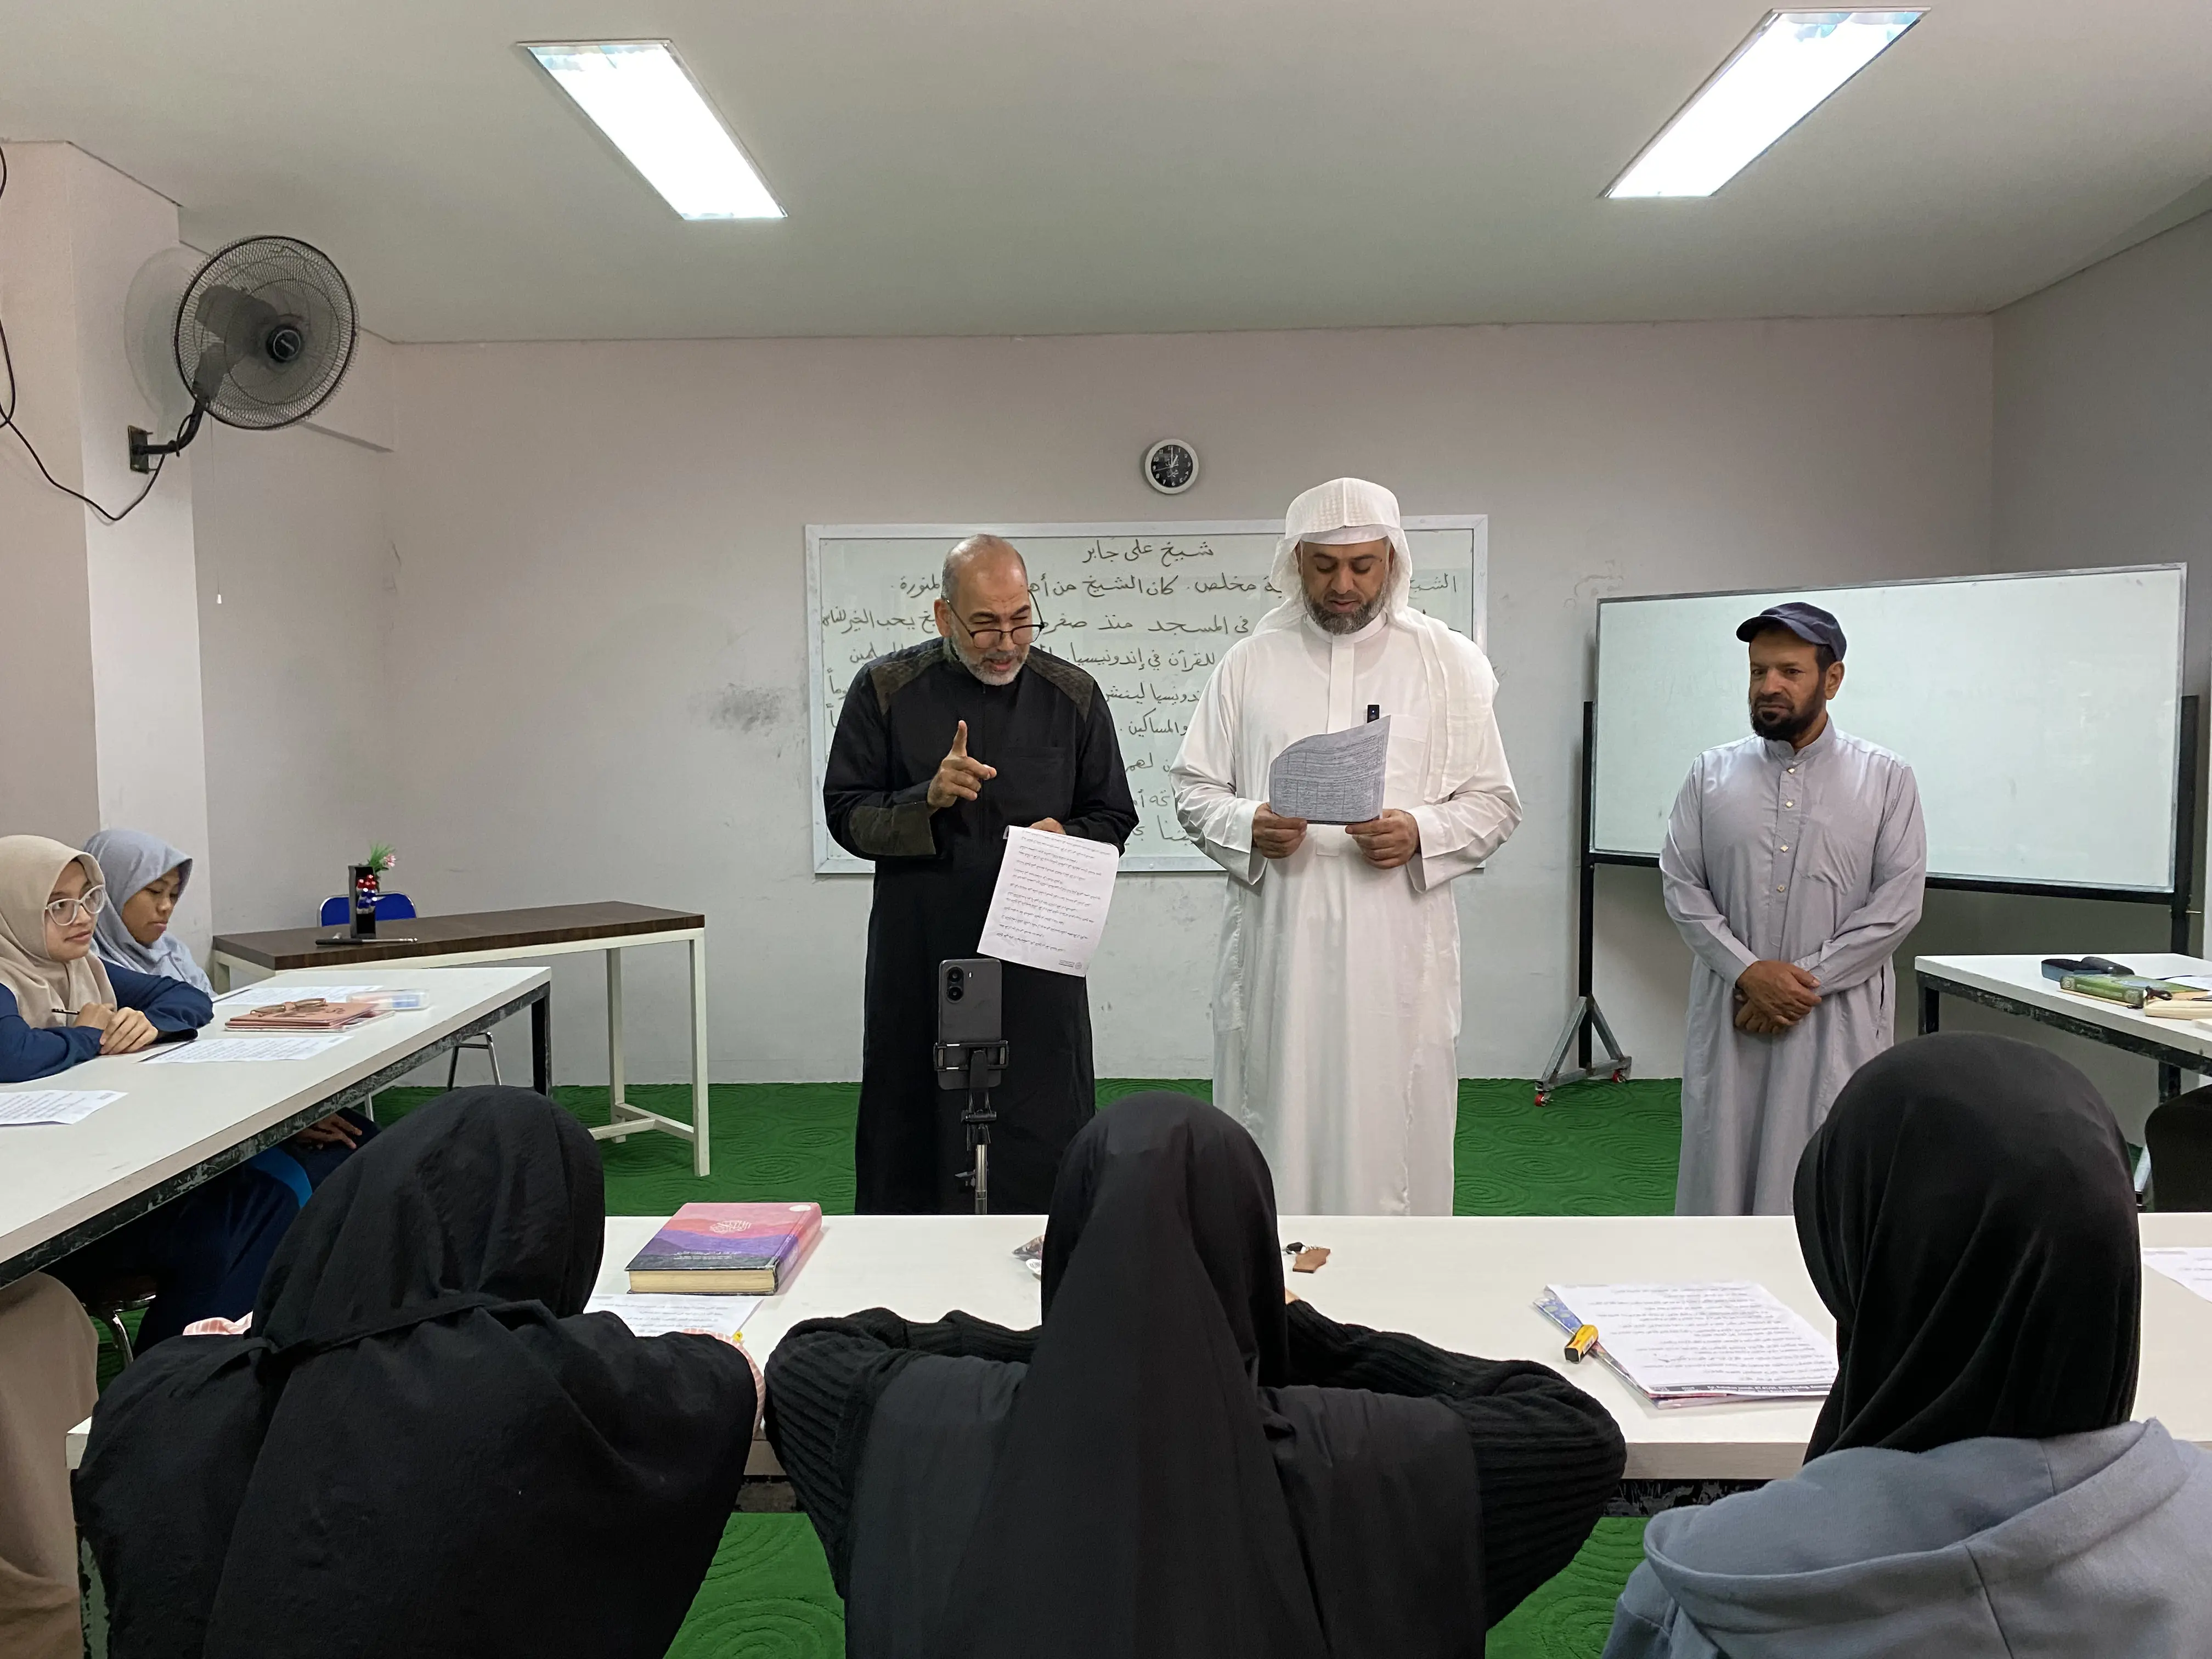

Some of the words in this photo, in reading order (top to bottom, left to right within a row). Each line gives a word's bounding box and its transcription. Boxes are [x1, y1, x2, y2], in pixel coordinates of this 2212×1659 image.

[1081, 539, 1119, 563] جابر
[1029, 573, 1048, 597] أه
[1053, 581, 1077, 596] من
[876, 617, 916, 630] يحب
[1098, 614, 1133, 630] منذ
[1147, 615, 1228, 636] المسجد
